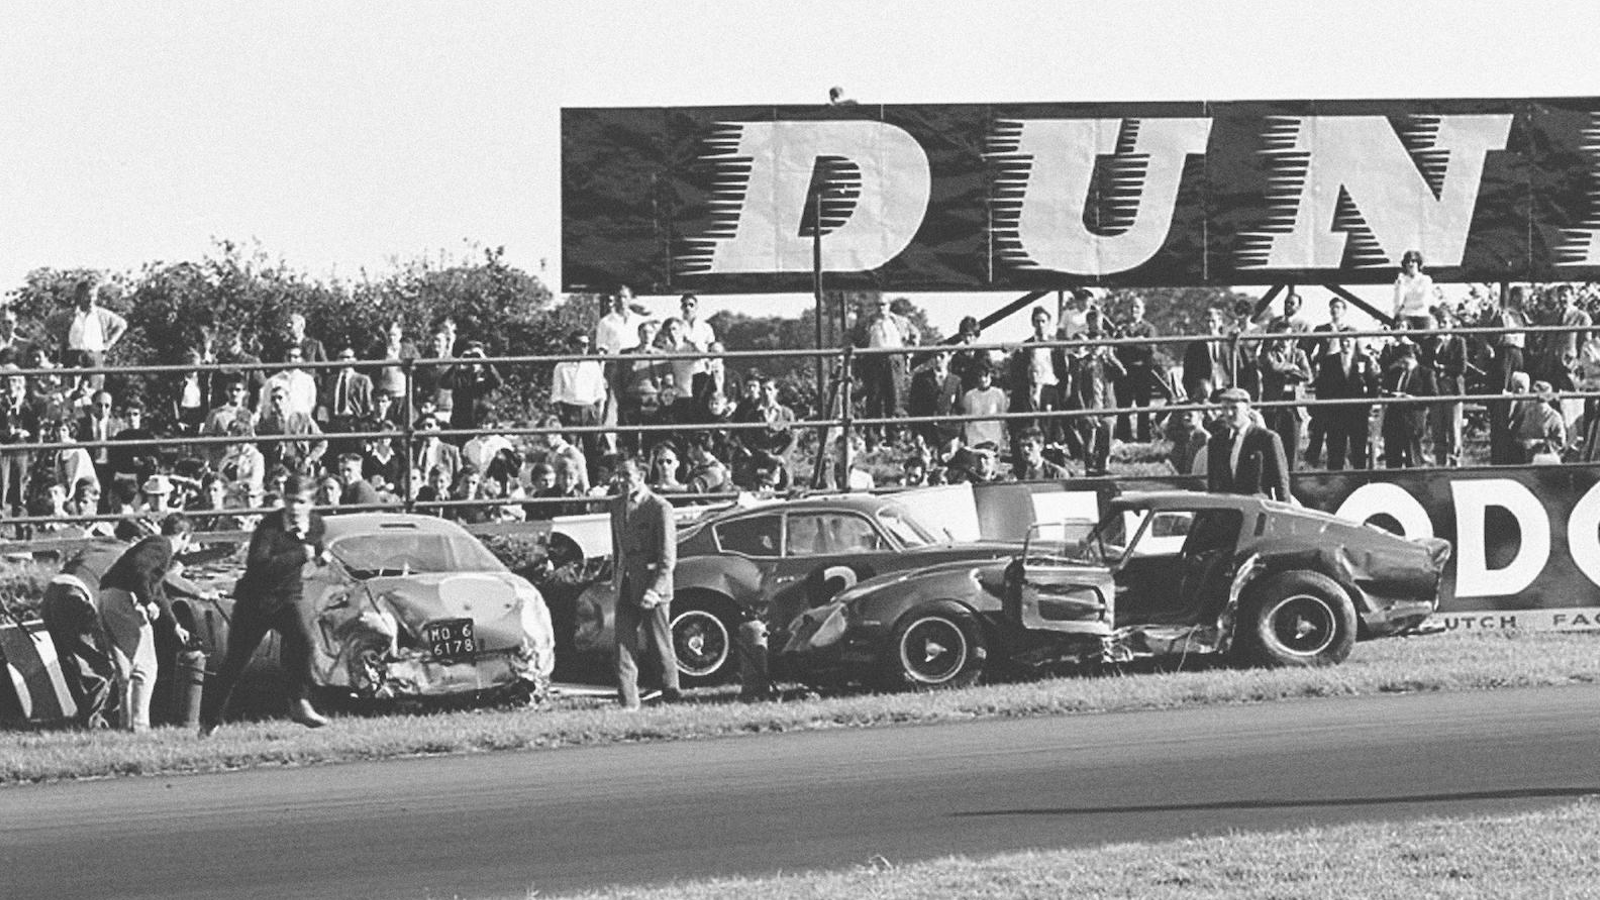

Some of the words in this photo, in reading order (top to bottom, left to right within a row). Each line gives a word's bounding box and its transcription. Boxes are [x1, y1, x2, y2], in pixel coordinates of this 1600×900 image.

[431, 627, 451, 641] MO
[462, 624, 471, 637] 6
[434, 639, 473, 655] 6178
